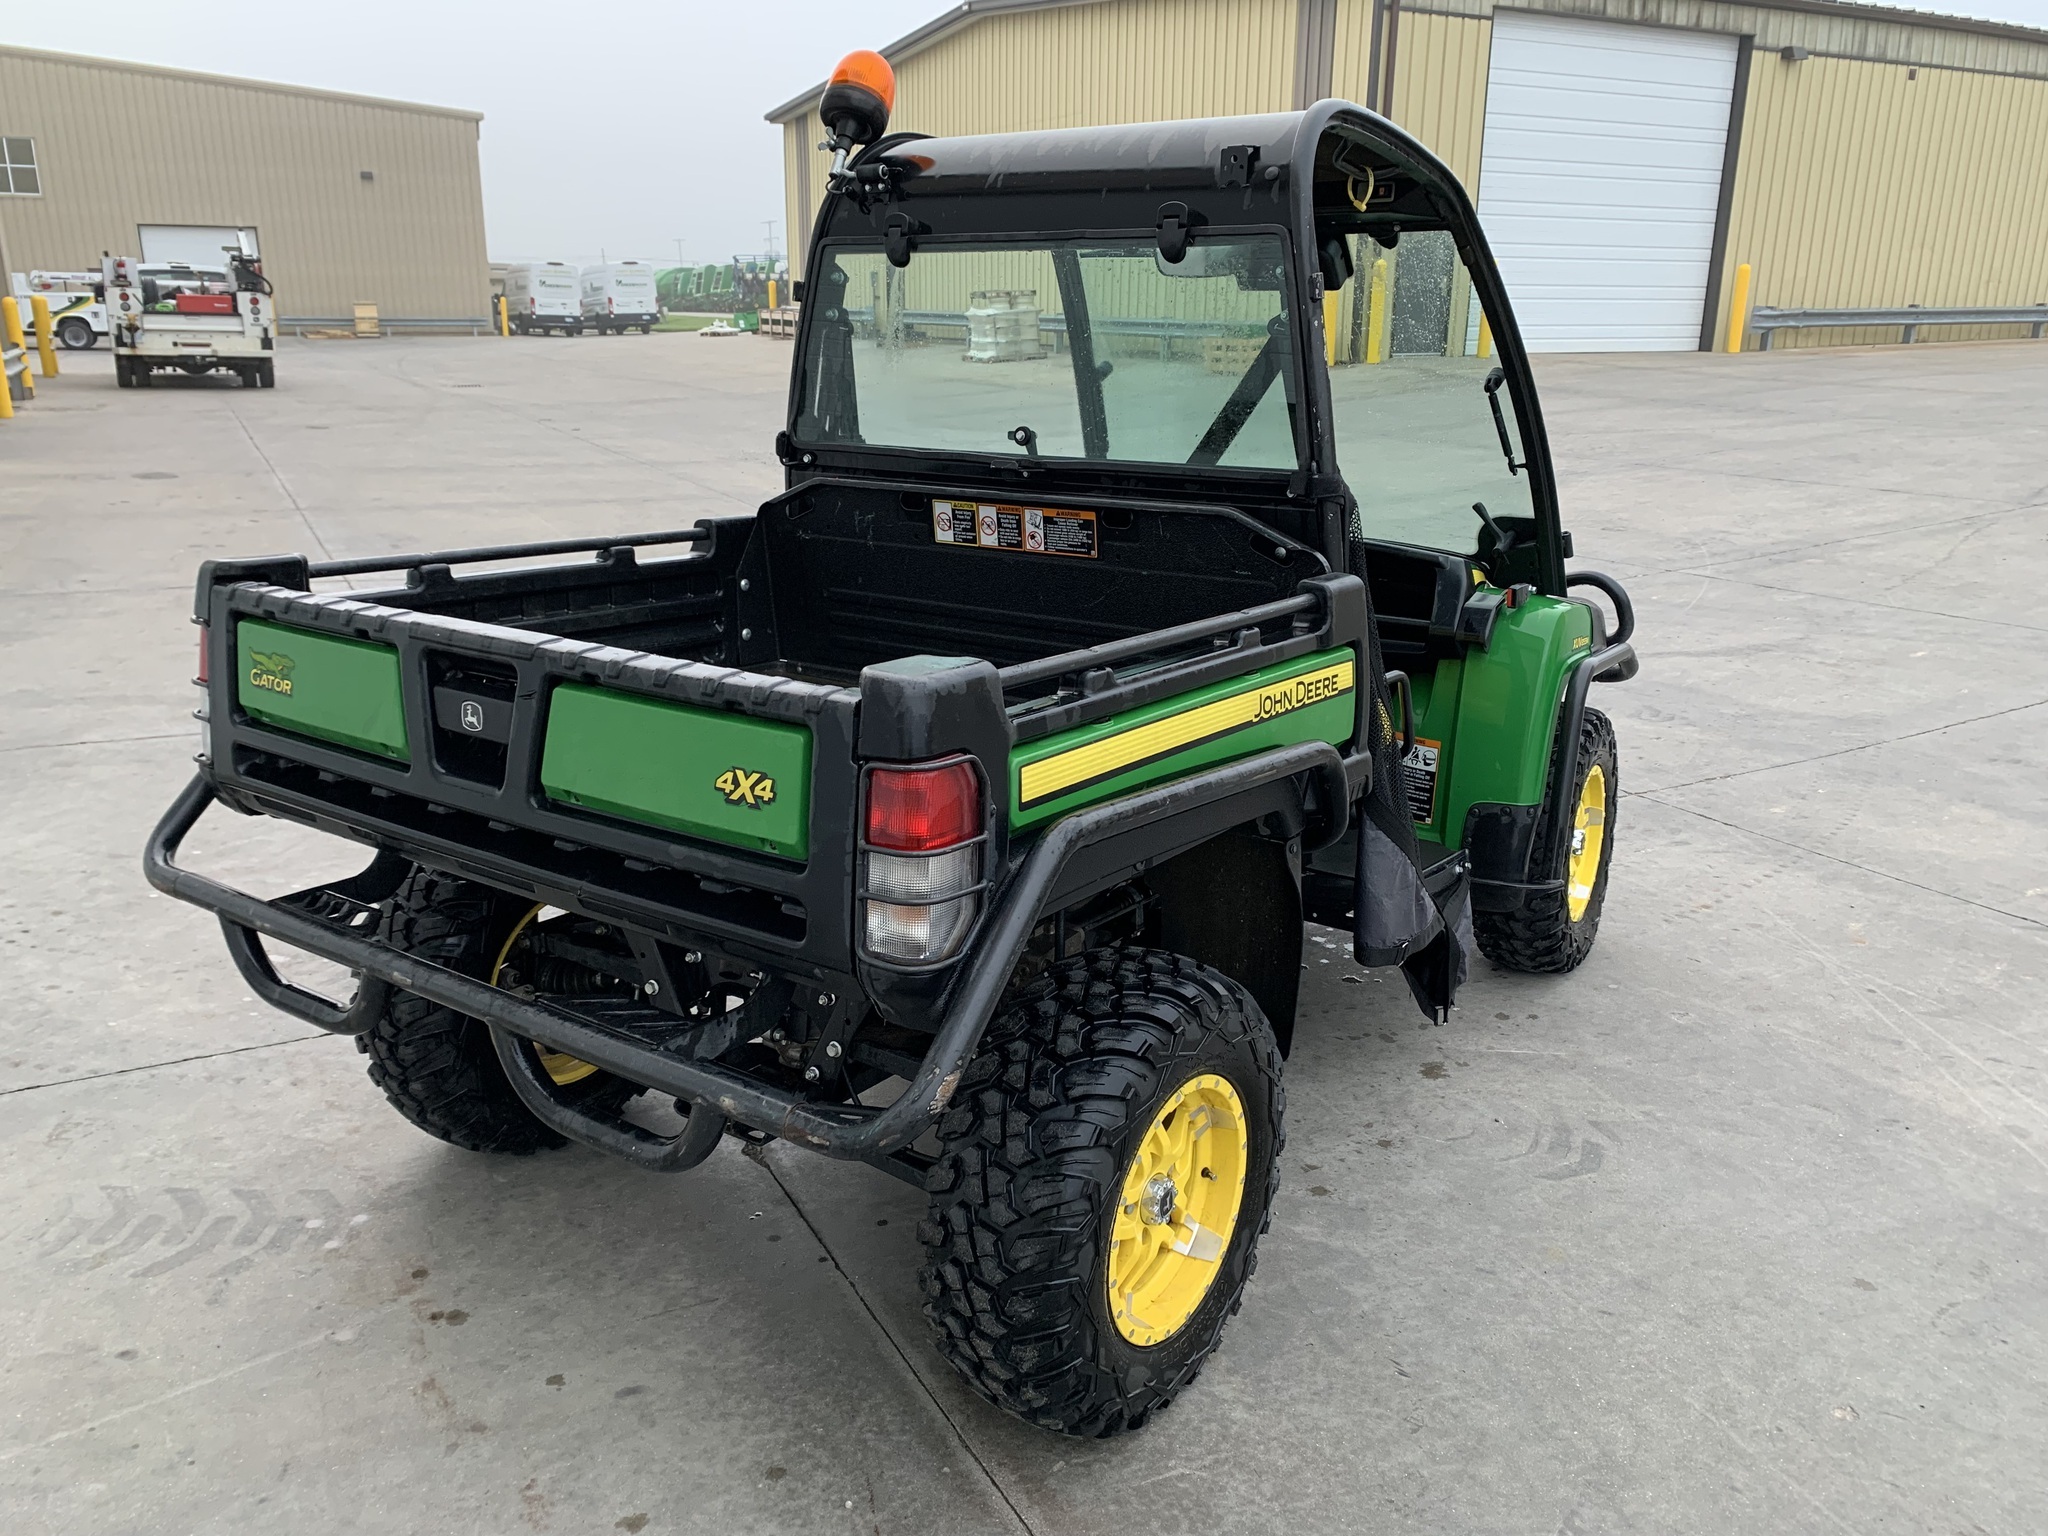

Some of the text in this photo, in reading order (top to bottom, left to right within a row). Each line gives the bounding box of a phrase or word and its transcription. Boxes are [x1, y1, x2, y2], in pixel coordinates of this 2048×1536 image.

[250, 668, 292, 695] GATOR
[1254, 674, 1339, 719] JOHN DEERE
[715, 768, 776, 807] 4X4
